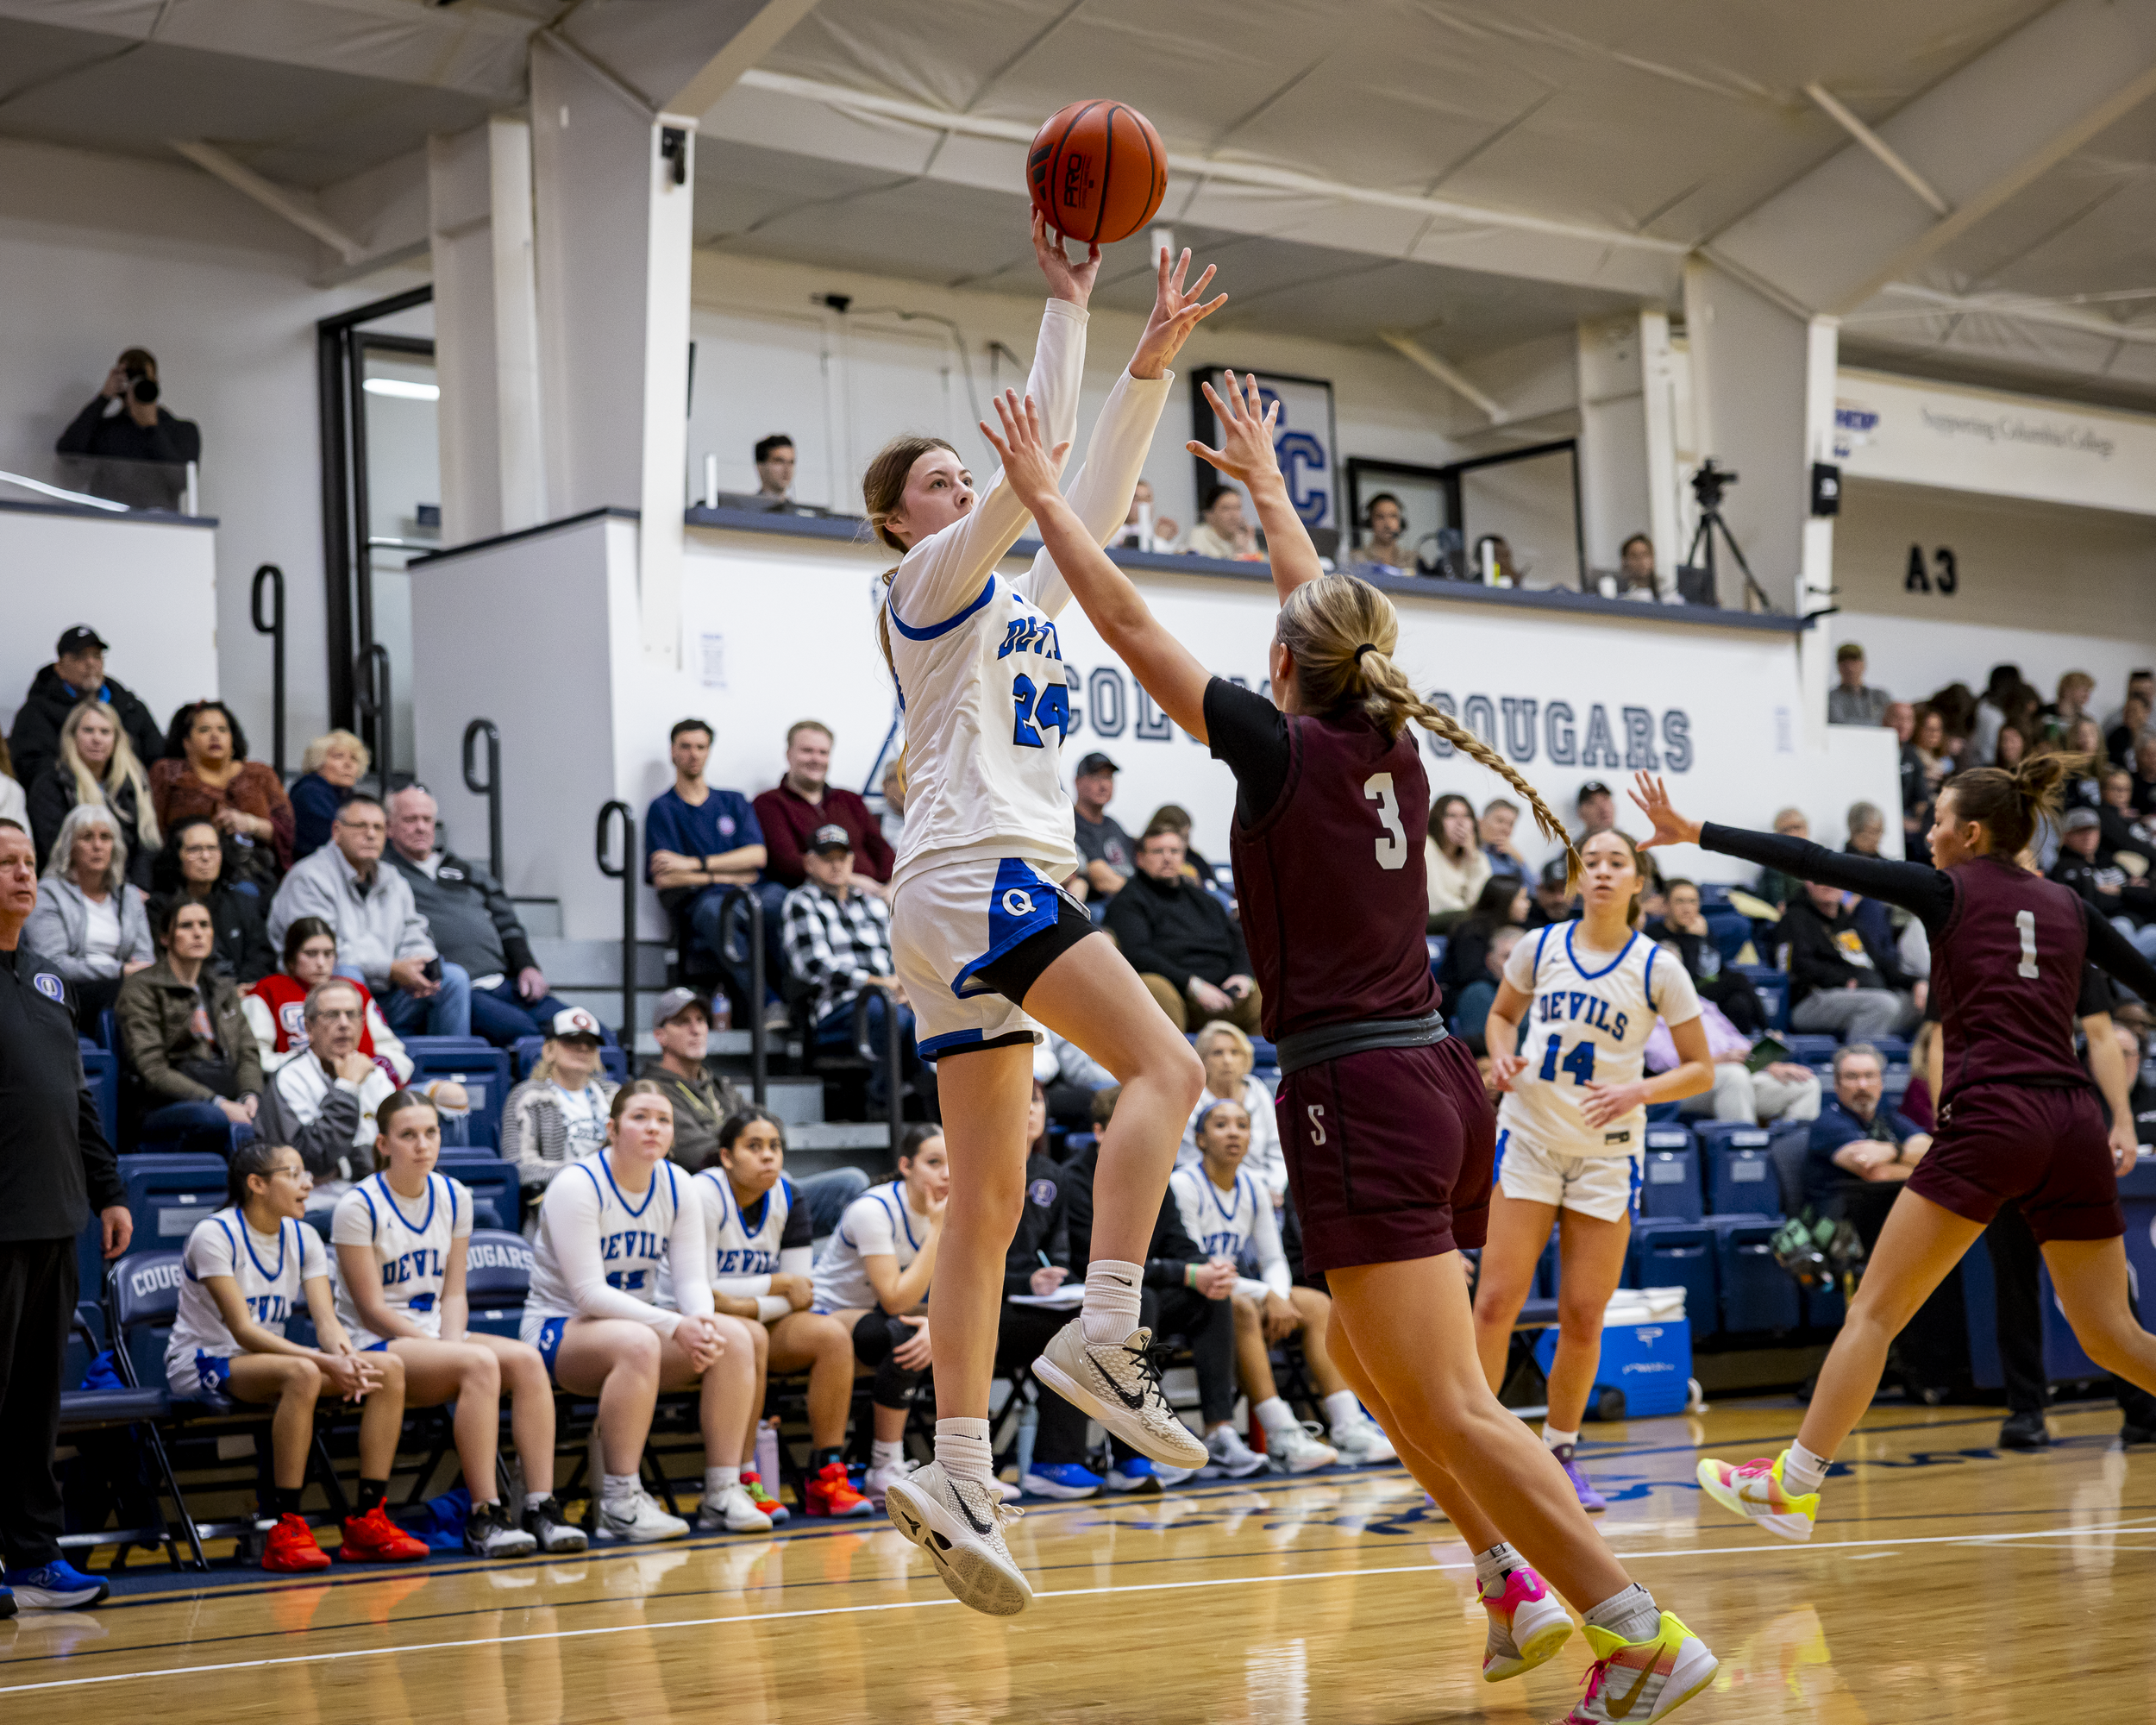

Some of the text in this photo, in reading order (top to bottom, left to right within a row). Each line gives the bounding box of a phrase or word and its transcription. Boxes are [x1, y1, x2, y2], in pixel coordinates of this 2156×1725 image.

[1063, 153, 1083, 208] PRO
[1012, 672, 1070, 749] 24
[1426, 692, 1695, 773] COUGARS
[1363, 772, 1407, 870] 3
[1002, 888, 1037, 917] Q
[2015, 909, 2040, 980] 1
[1539, 991, 1628, 1042] DEVILS
[1539, 1032, 1595, 1087] 14
[1307, 1104, 1326, 1146] S
[601, 1231, 670, 1260] EVIL
[131, 1264, 182, 1297] COUG
